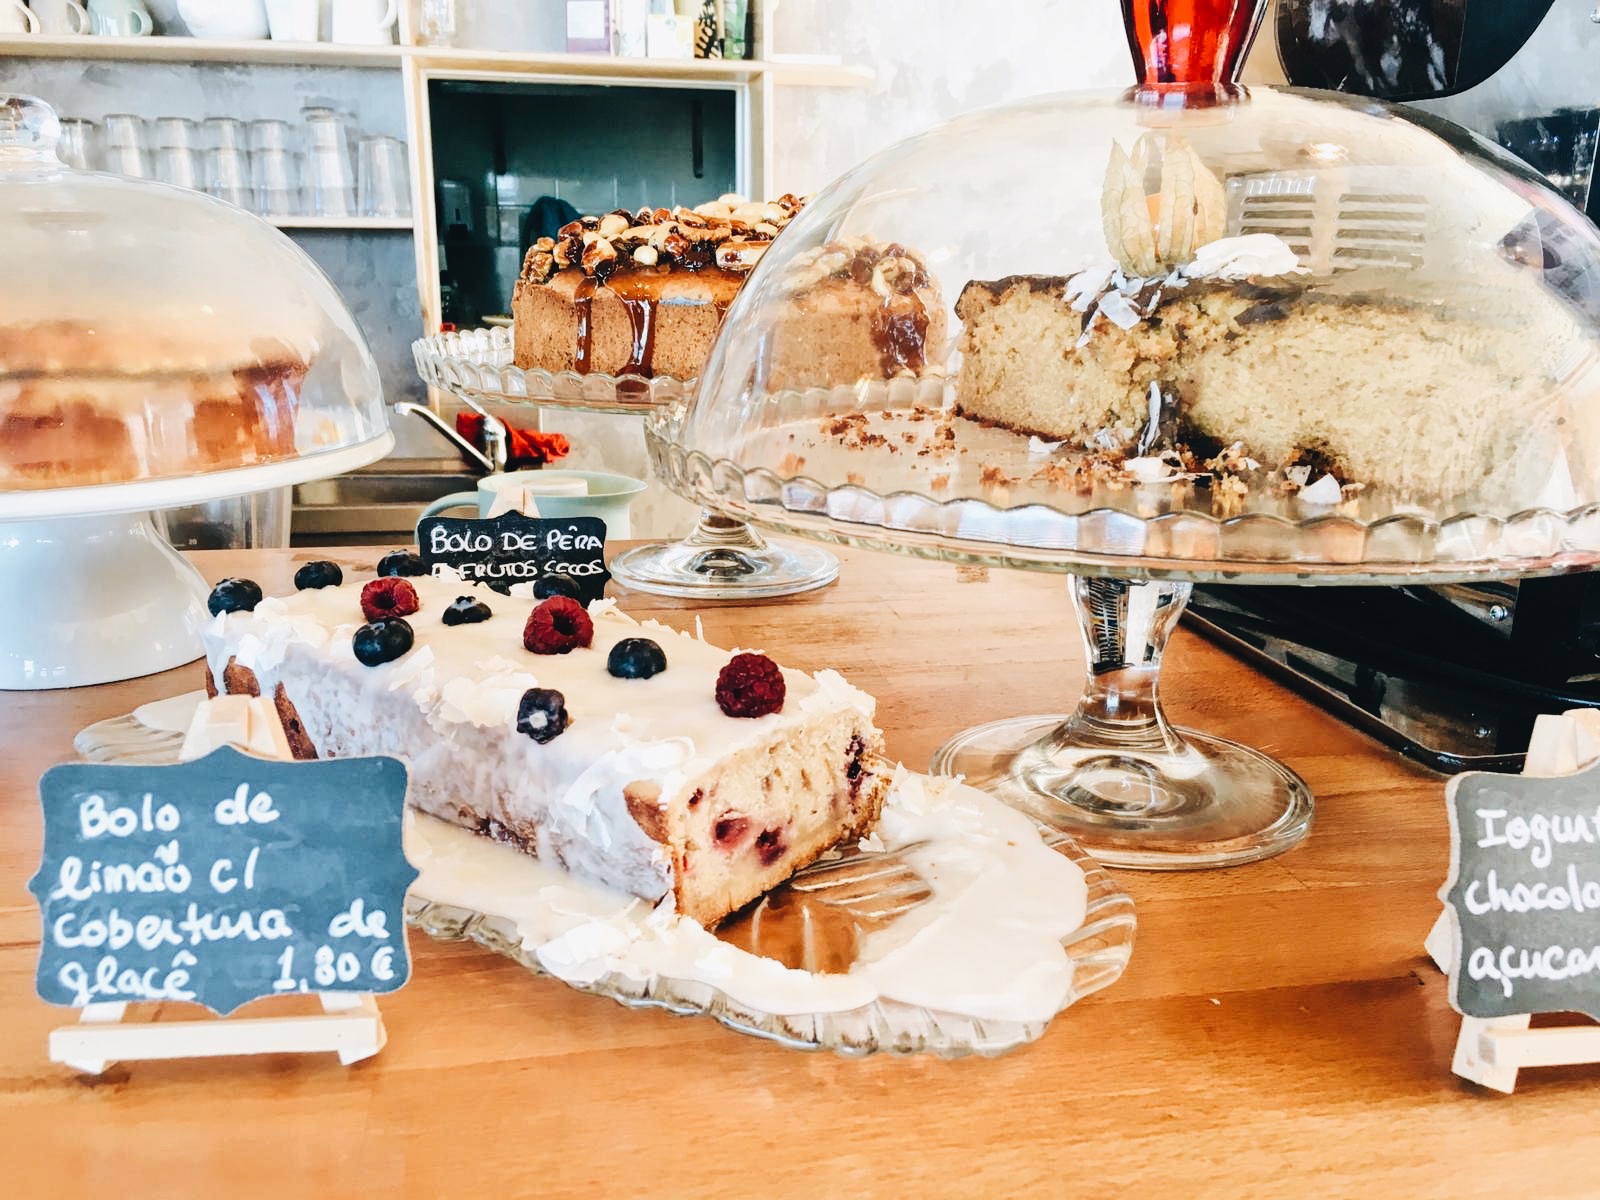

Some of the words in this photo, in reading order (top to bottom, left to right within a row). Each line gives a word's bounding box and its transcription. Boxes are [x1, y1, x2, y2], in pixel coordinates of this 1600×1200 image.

[498, 531, 537, 551] DE
[458, 559, 538, 580] FRUTOS
[78, 792, 180, 840] Bolo
[214, 783, 281, 826] de
[50, 839, 193, 901] limão
[327, 897, 392, 939] de
[57, 949, 198, 1006] glacê
